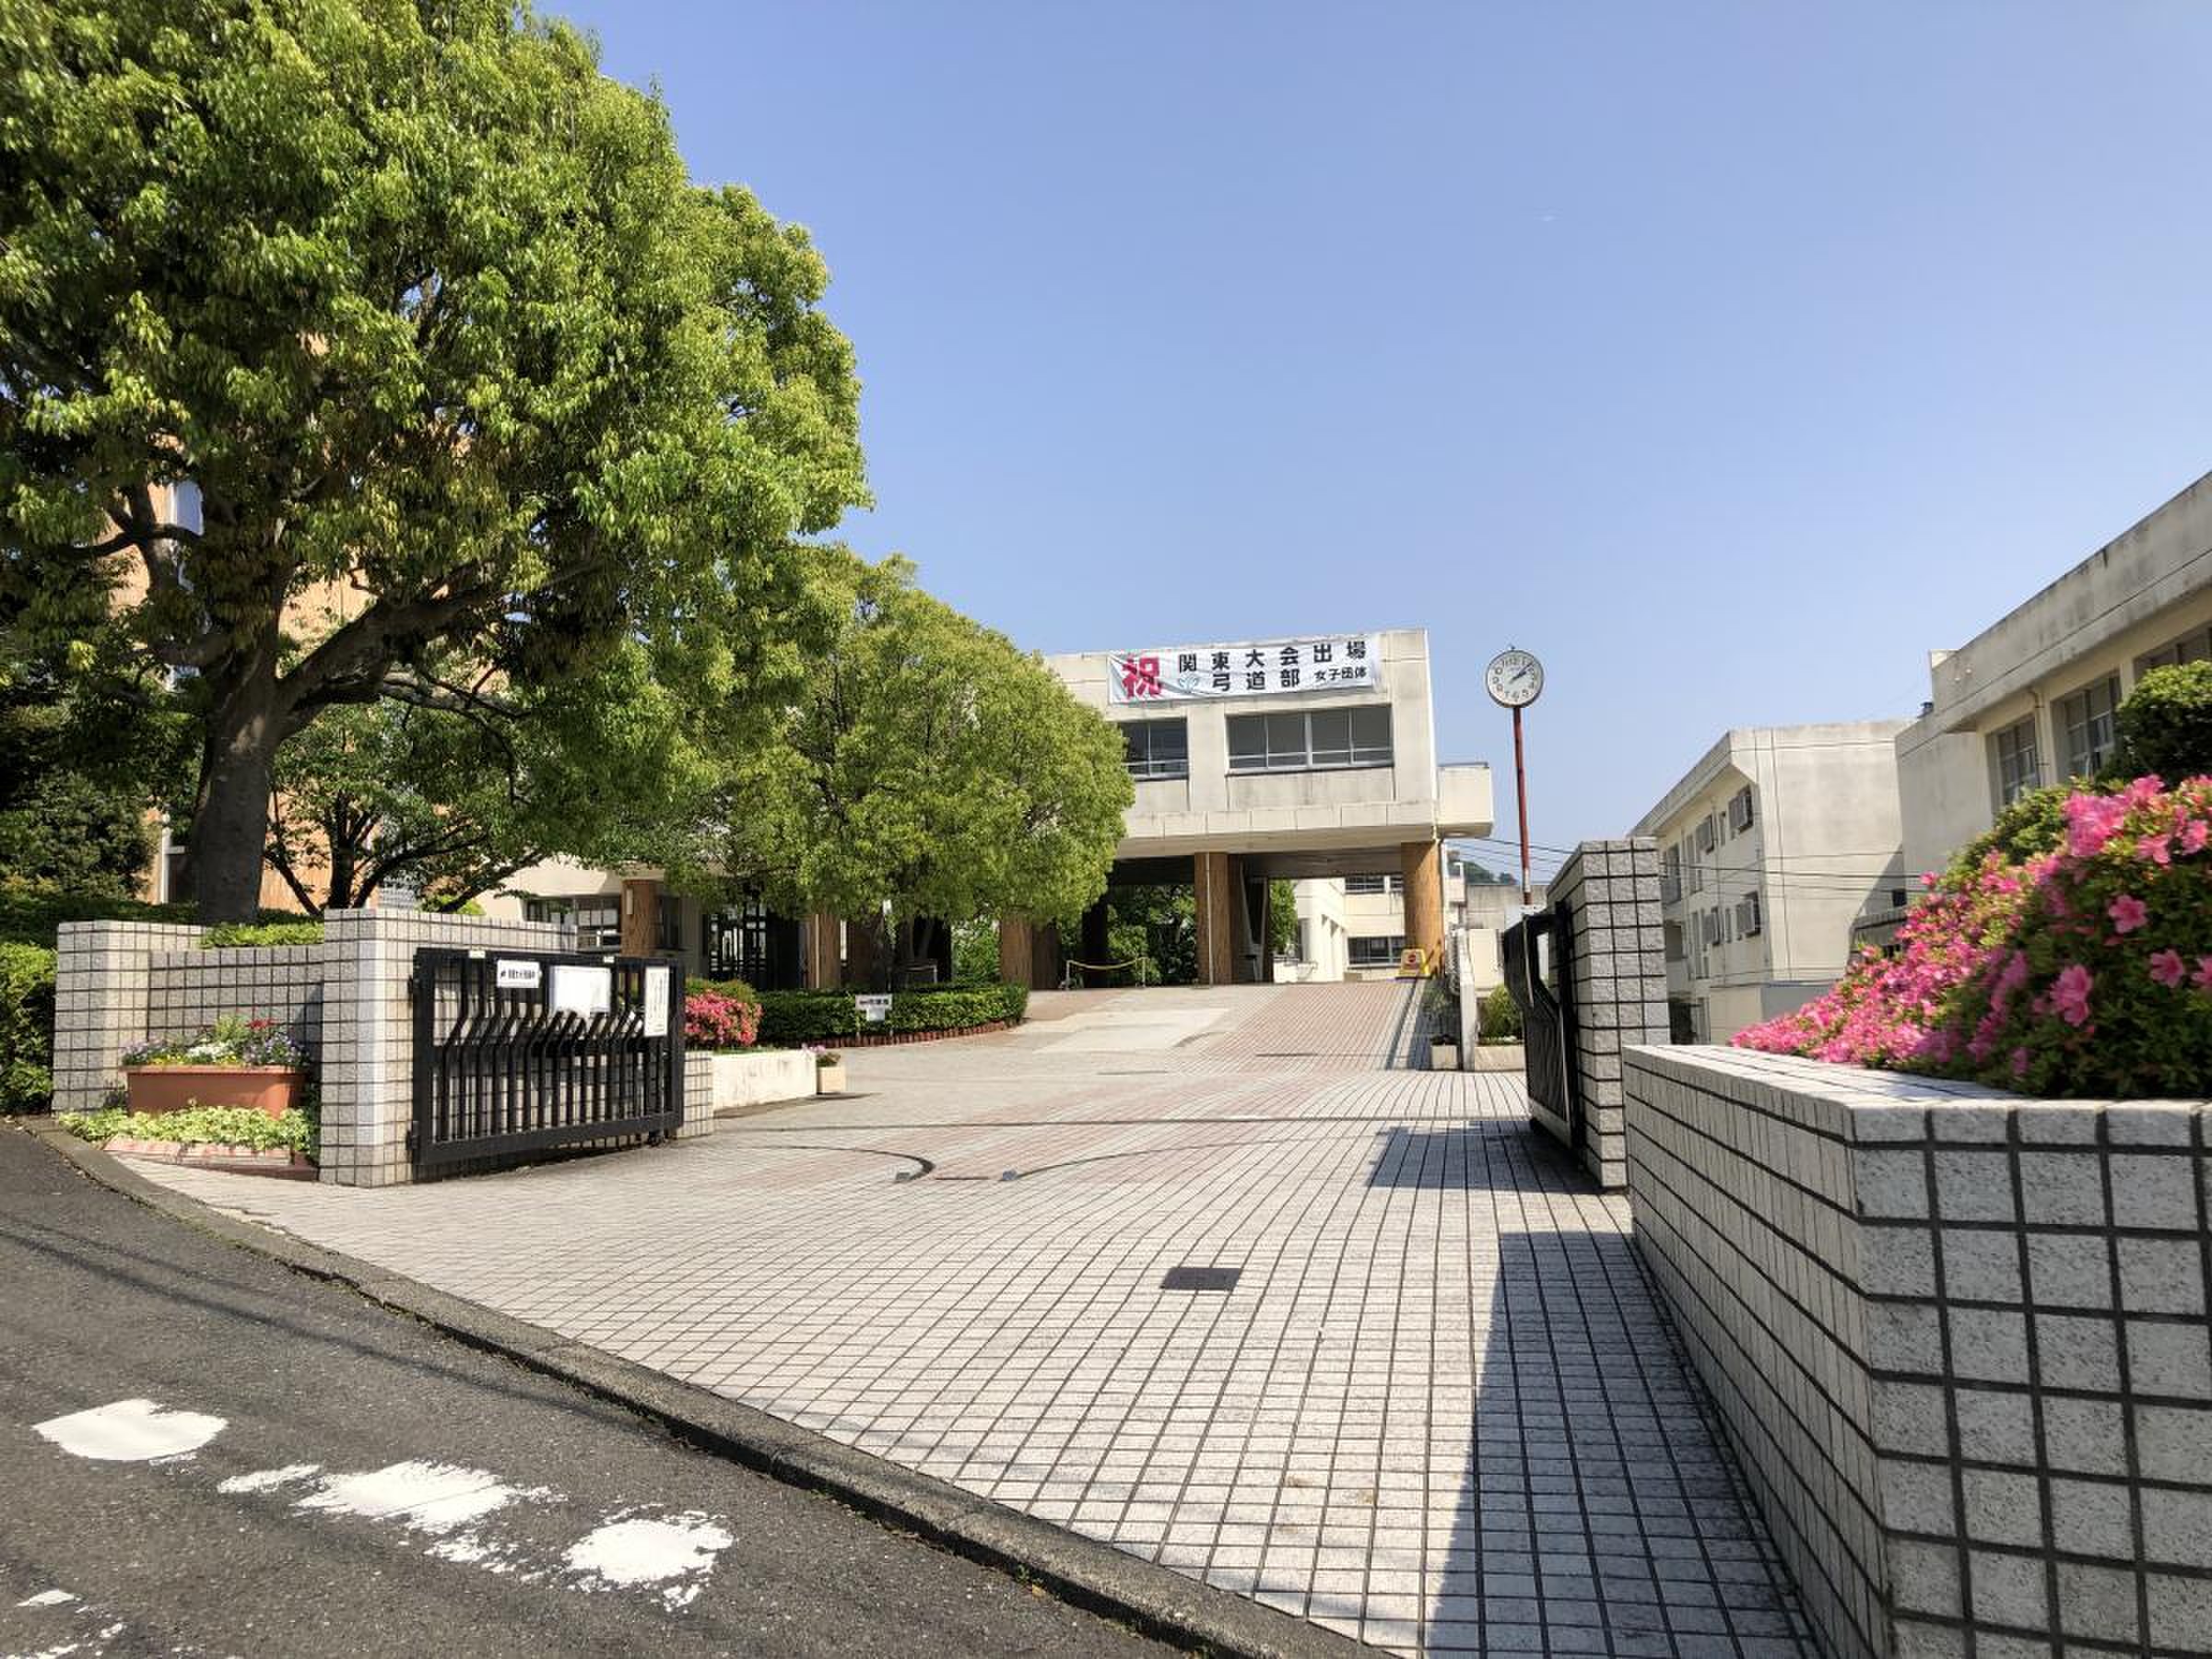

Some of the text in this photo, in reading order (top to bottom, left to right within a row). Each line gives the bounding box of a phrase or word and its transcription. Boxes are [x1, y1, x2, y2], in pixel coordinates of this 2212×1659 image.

[1179, 641, 1366, 673] 関東大会出場
[1122, 653, 1161, 698] 祝
[1212, 669, 1300, 691] 弓道部
